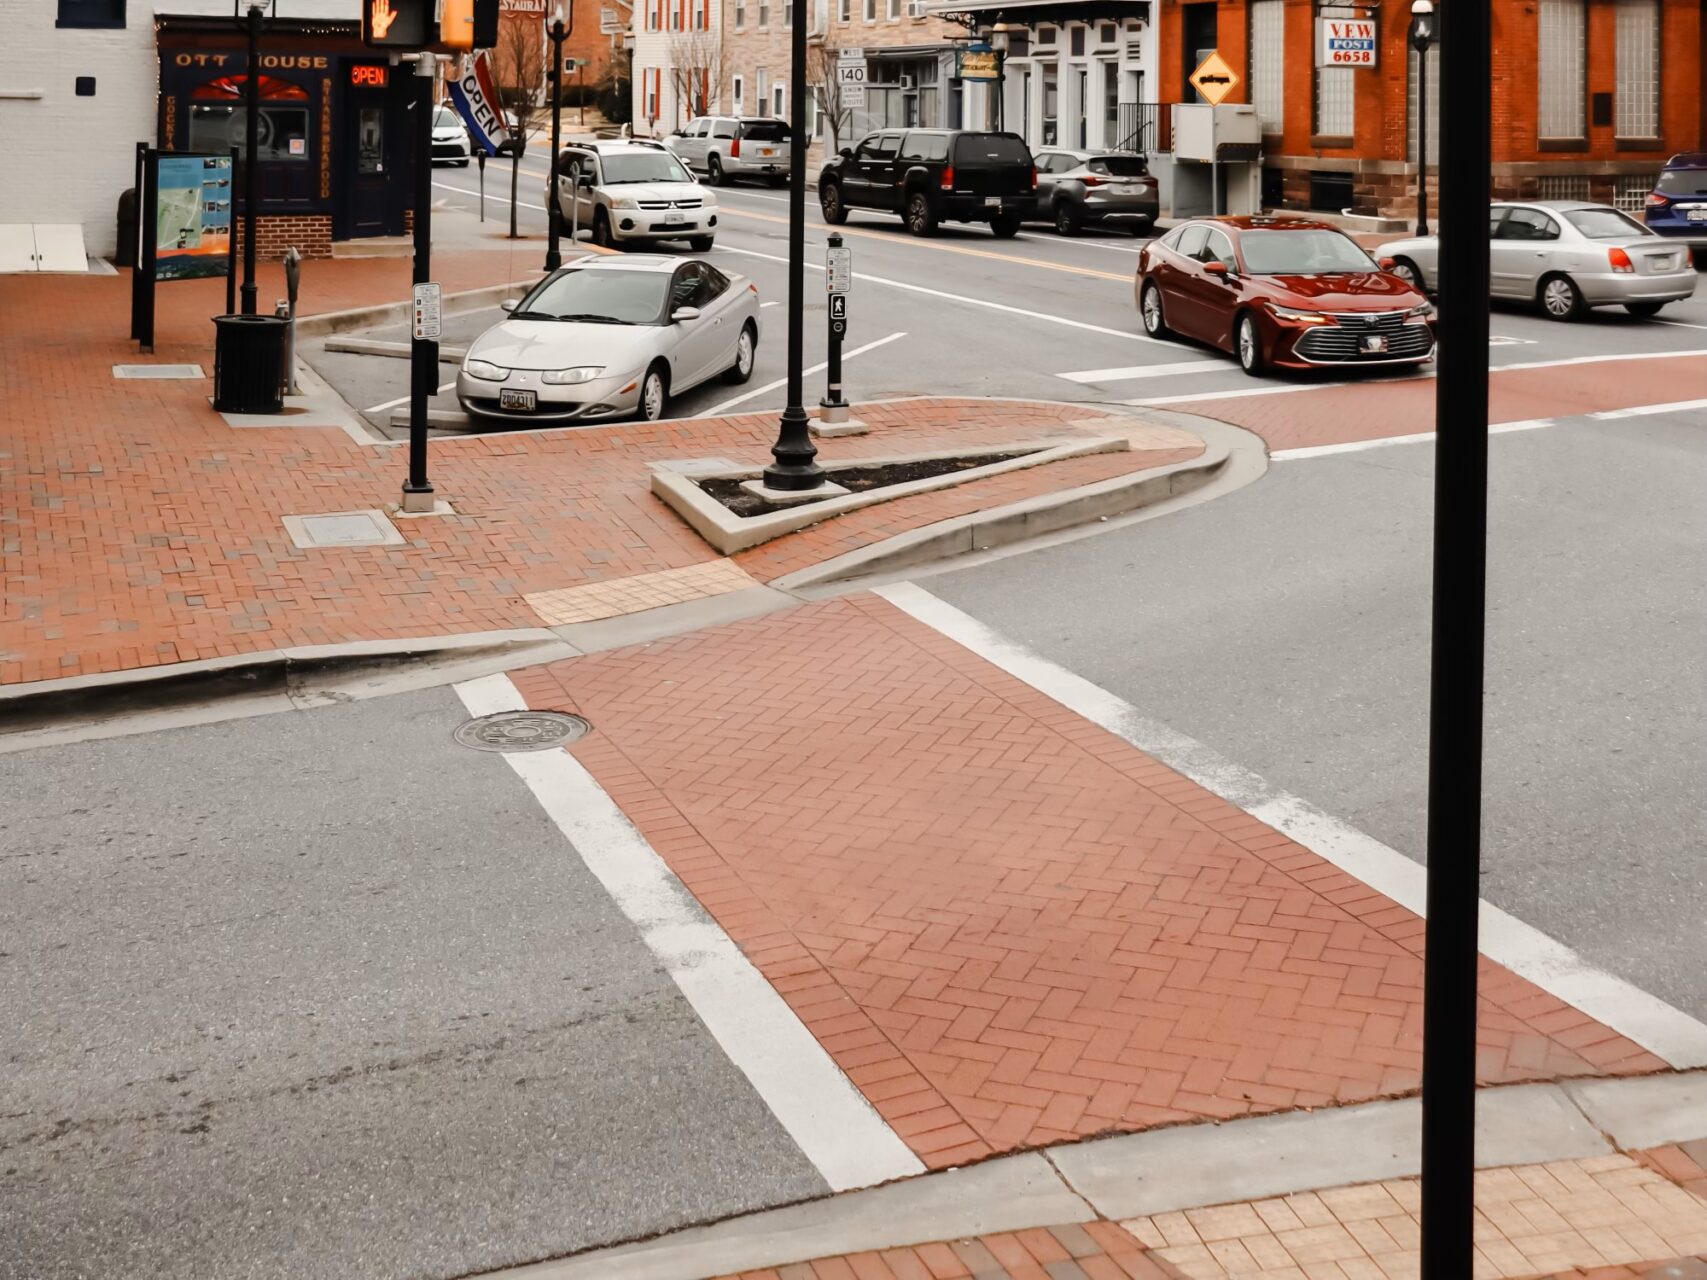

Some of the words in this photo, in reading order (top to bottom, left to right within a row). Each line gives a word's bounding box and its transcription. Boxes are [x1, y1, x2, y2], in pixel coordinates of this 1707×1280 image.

[1333, 39, 1369, 49] POST
[175, 53, 229, 66] OTT
[1333, 51, 1370, 63] 6658
[352, 66, 384, 85] OPEN
[841, 68, 864, 81] 140
[463, 75, 500, 137] OPEN
